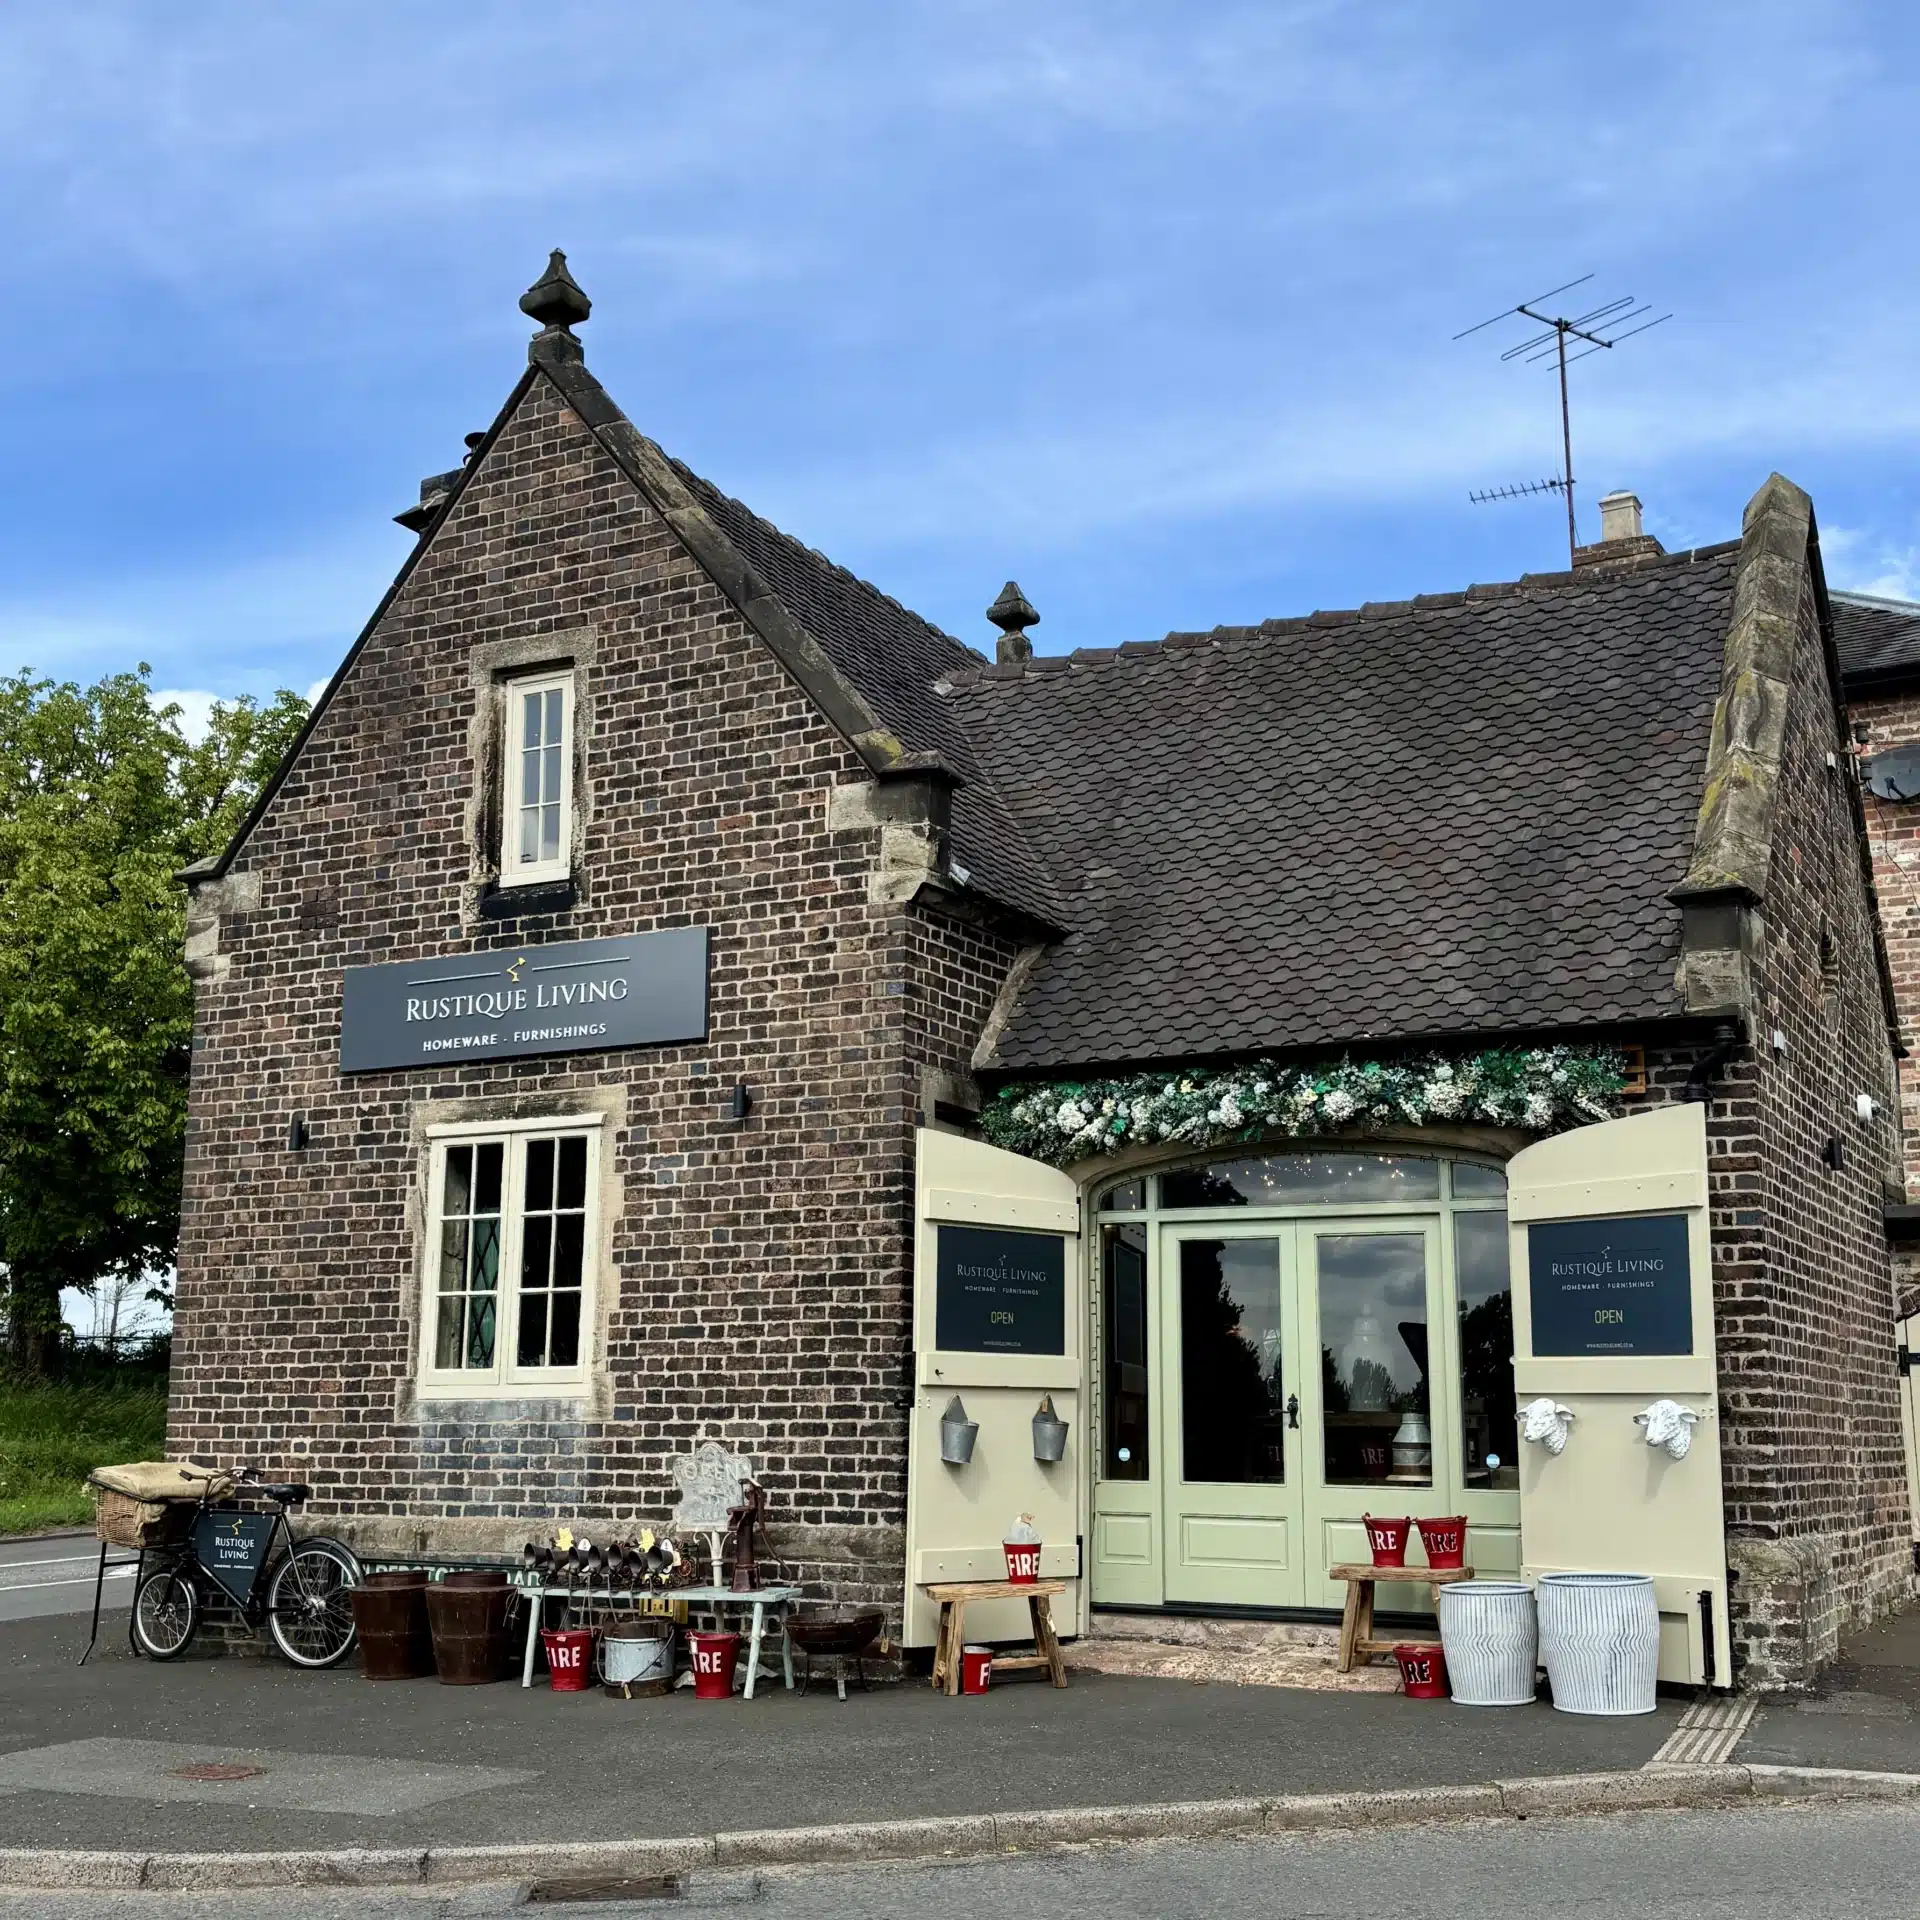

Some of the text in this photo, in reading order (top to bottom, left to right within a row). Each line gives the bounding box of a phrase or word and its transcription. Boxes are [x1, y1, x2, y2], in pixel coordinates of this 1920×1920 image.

[405, 978, 629, 1021] RUSTIQUE LIVING
[422, 1033, 498, 1052] HOMEWARE
[513, 1022, 608, 1043] FURNISHINGS
[957, 1264, 1047, 1282] RUSTIQUE LIVING
[1551, 1259, 1664, 1277] RUSTIQUE LIVING
[964, 1285, 1039, 1296] HOMEWARE FURNISHINGS
[1561, 1281, 1655, 1292] HOMEWARE FURNISHINGS
[990, 1310, 1014, 1325] OPEN
[1594, 1309, 1624, 1324] OPEN
[1360, 1447, 1385, 1465] IRE
[215, 1536, 255, 1549] RUSTIQUE
[1368, 1530, 1397, 1551] IRE
[220, 1549, 249, 1560] LIVING
[1006, 1552, 1040, 1576] FIRE
[693, 1651, 722, 1674] IRE
